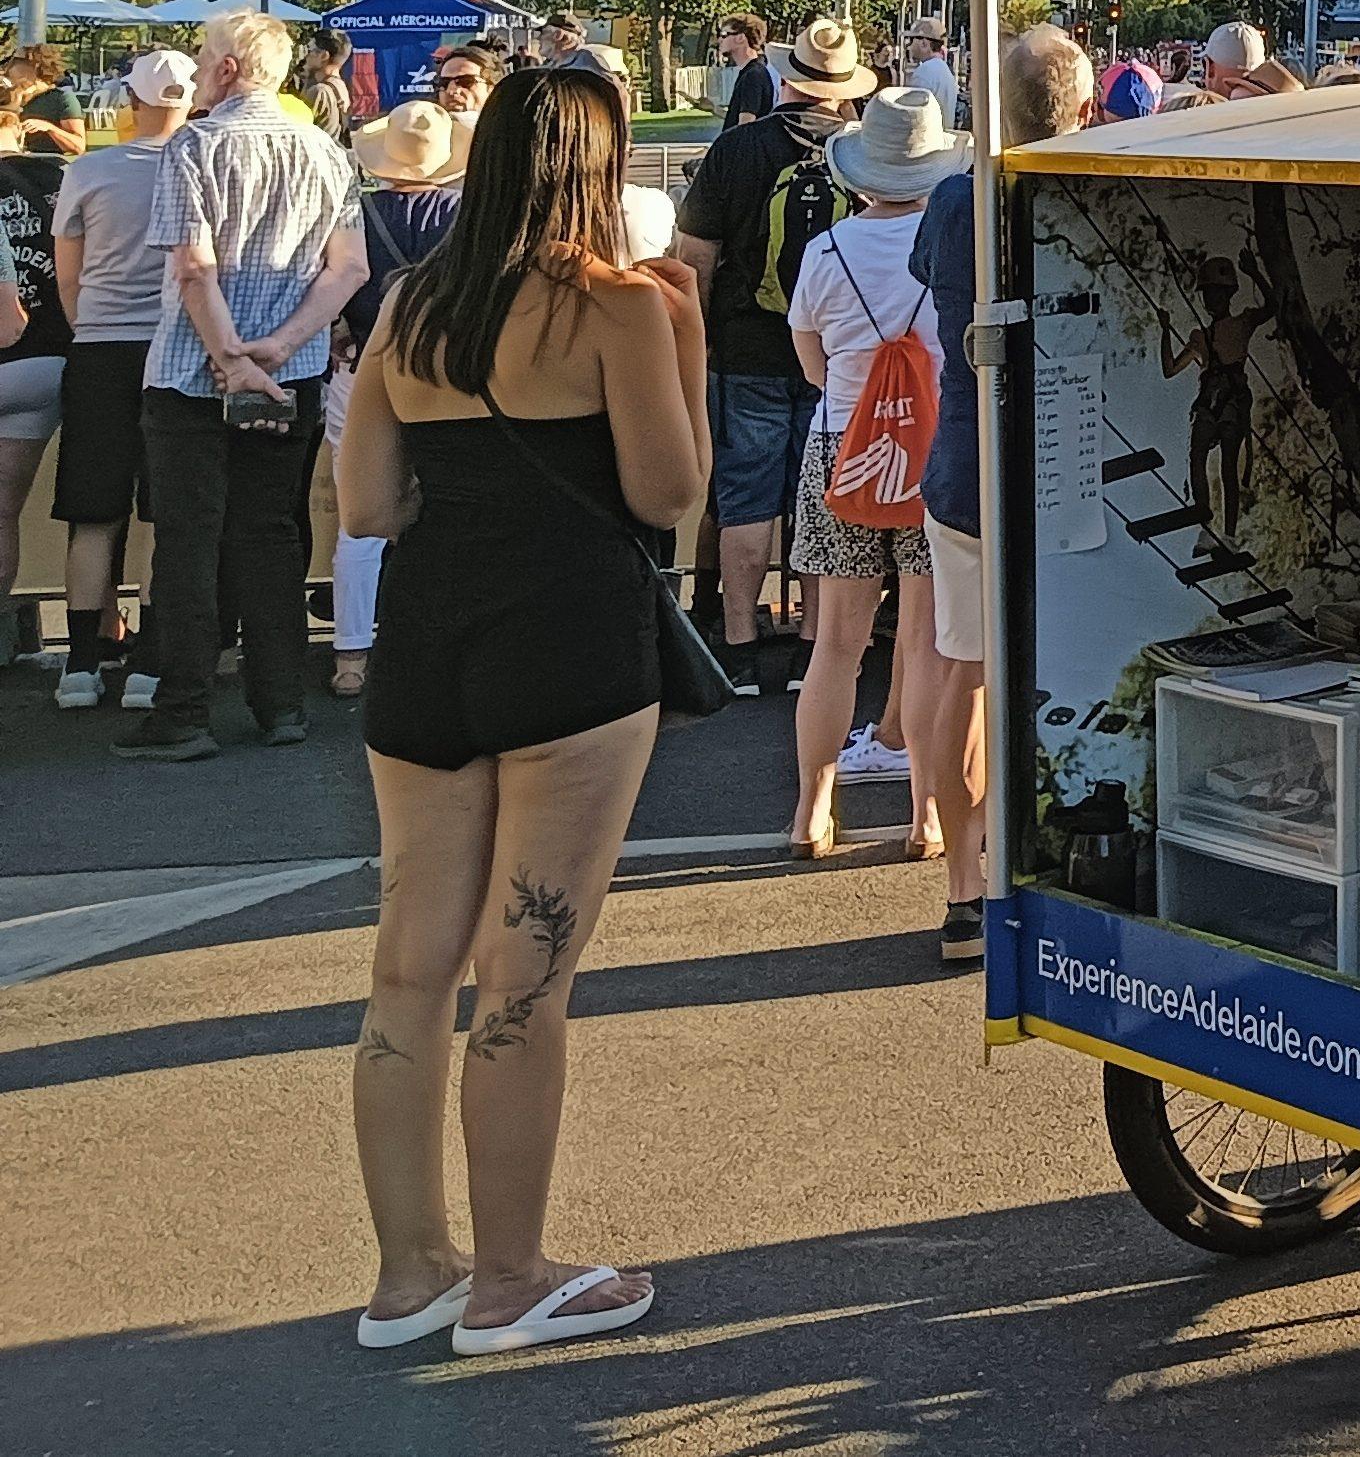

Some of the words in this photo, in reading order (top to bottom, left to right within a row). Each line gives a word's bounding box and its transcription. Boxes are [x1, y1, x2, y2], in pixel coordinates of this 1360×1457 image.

[330, 15, 385, 28] OFFICIAL
[390, 14, 479, 27] MERCHANDISE
[1062, 374, 1091, 386] Harbor
